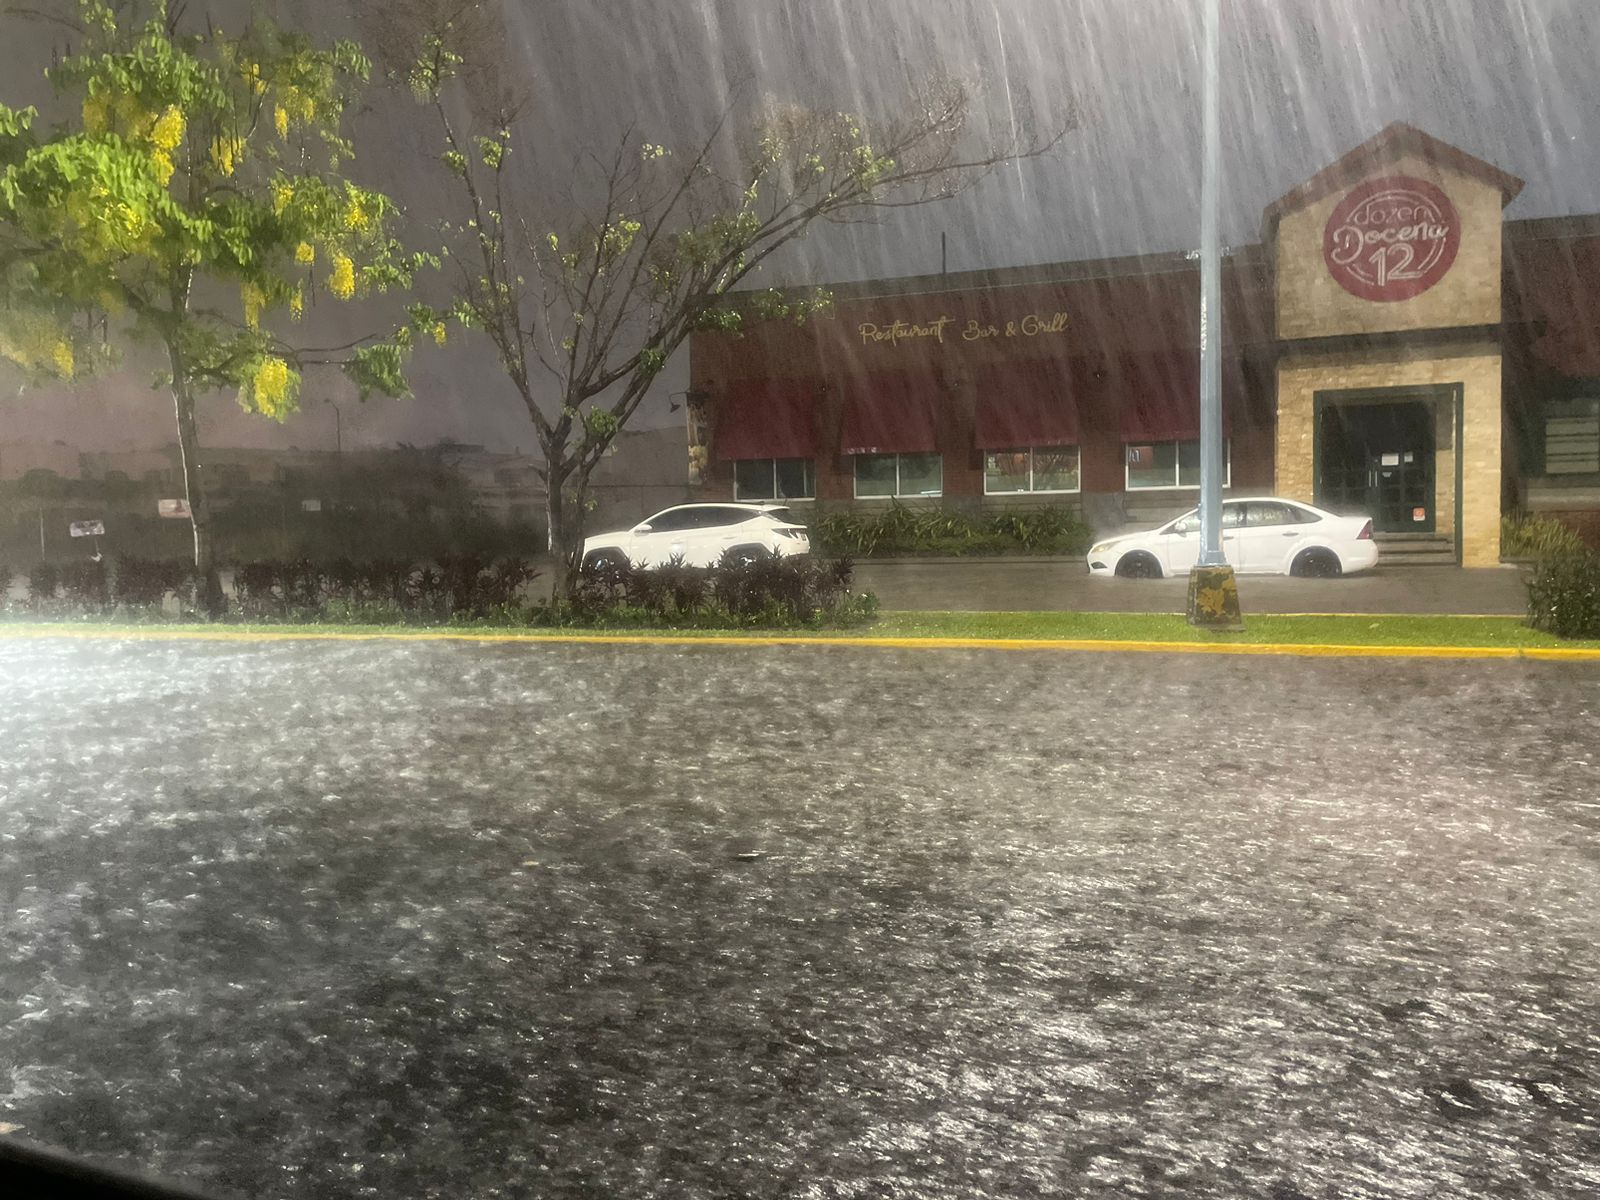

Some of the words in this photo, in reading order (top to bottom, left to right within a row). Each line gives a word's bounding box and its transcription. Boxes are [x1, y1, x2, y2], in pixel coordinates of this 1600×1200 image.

[1331, 222, 1450, 264] Docena
[1368, 242, 1423, 286] 12
[858, 316, 956, 347] Restaurant
[962, 319, 999, 341] Bar
[1005, 321, 1017, 338] &
[1021, 312, 1069, 336] Grill
